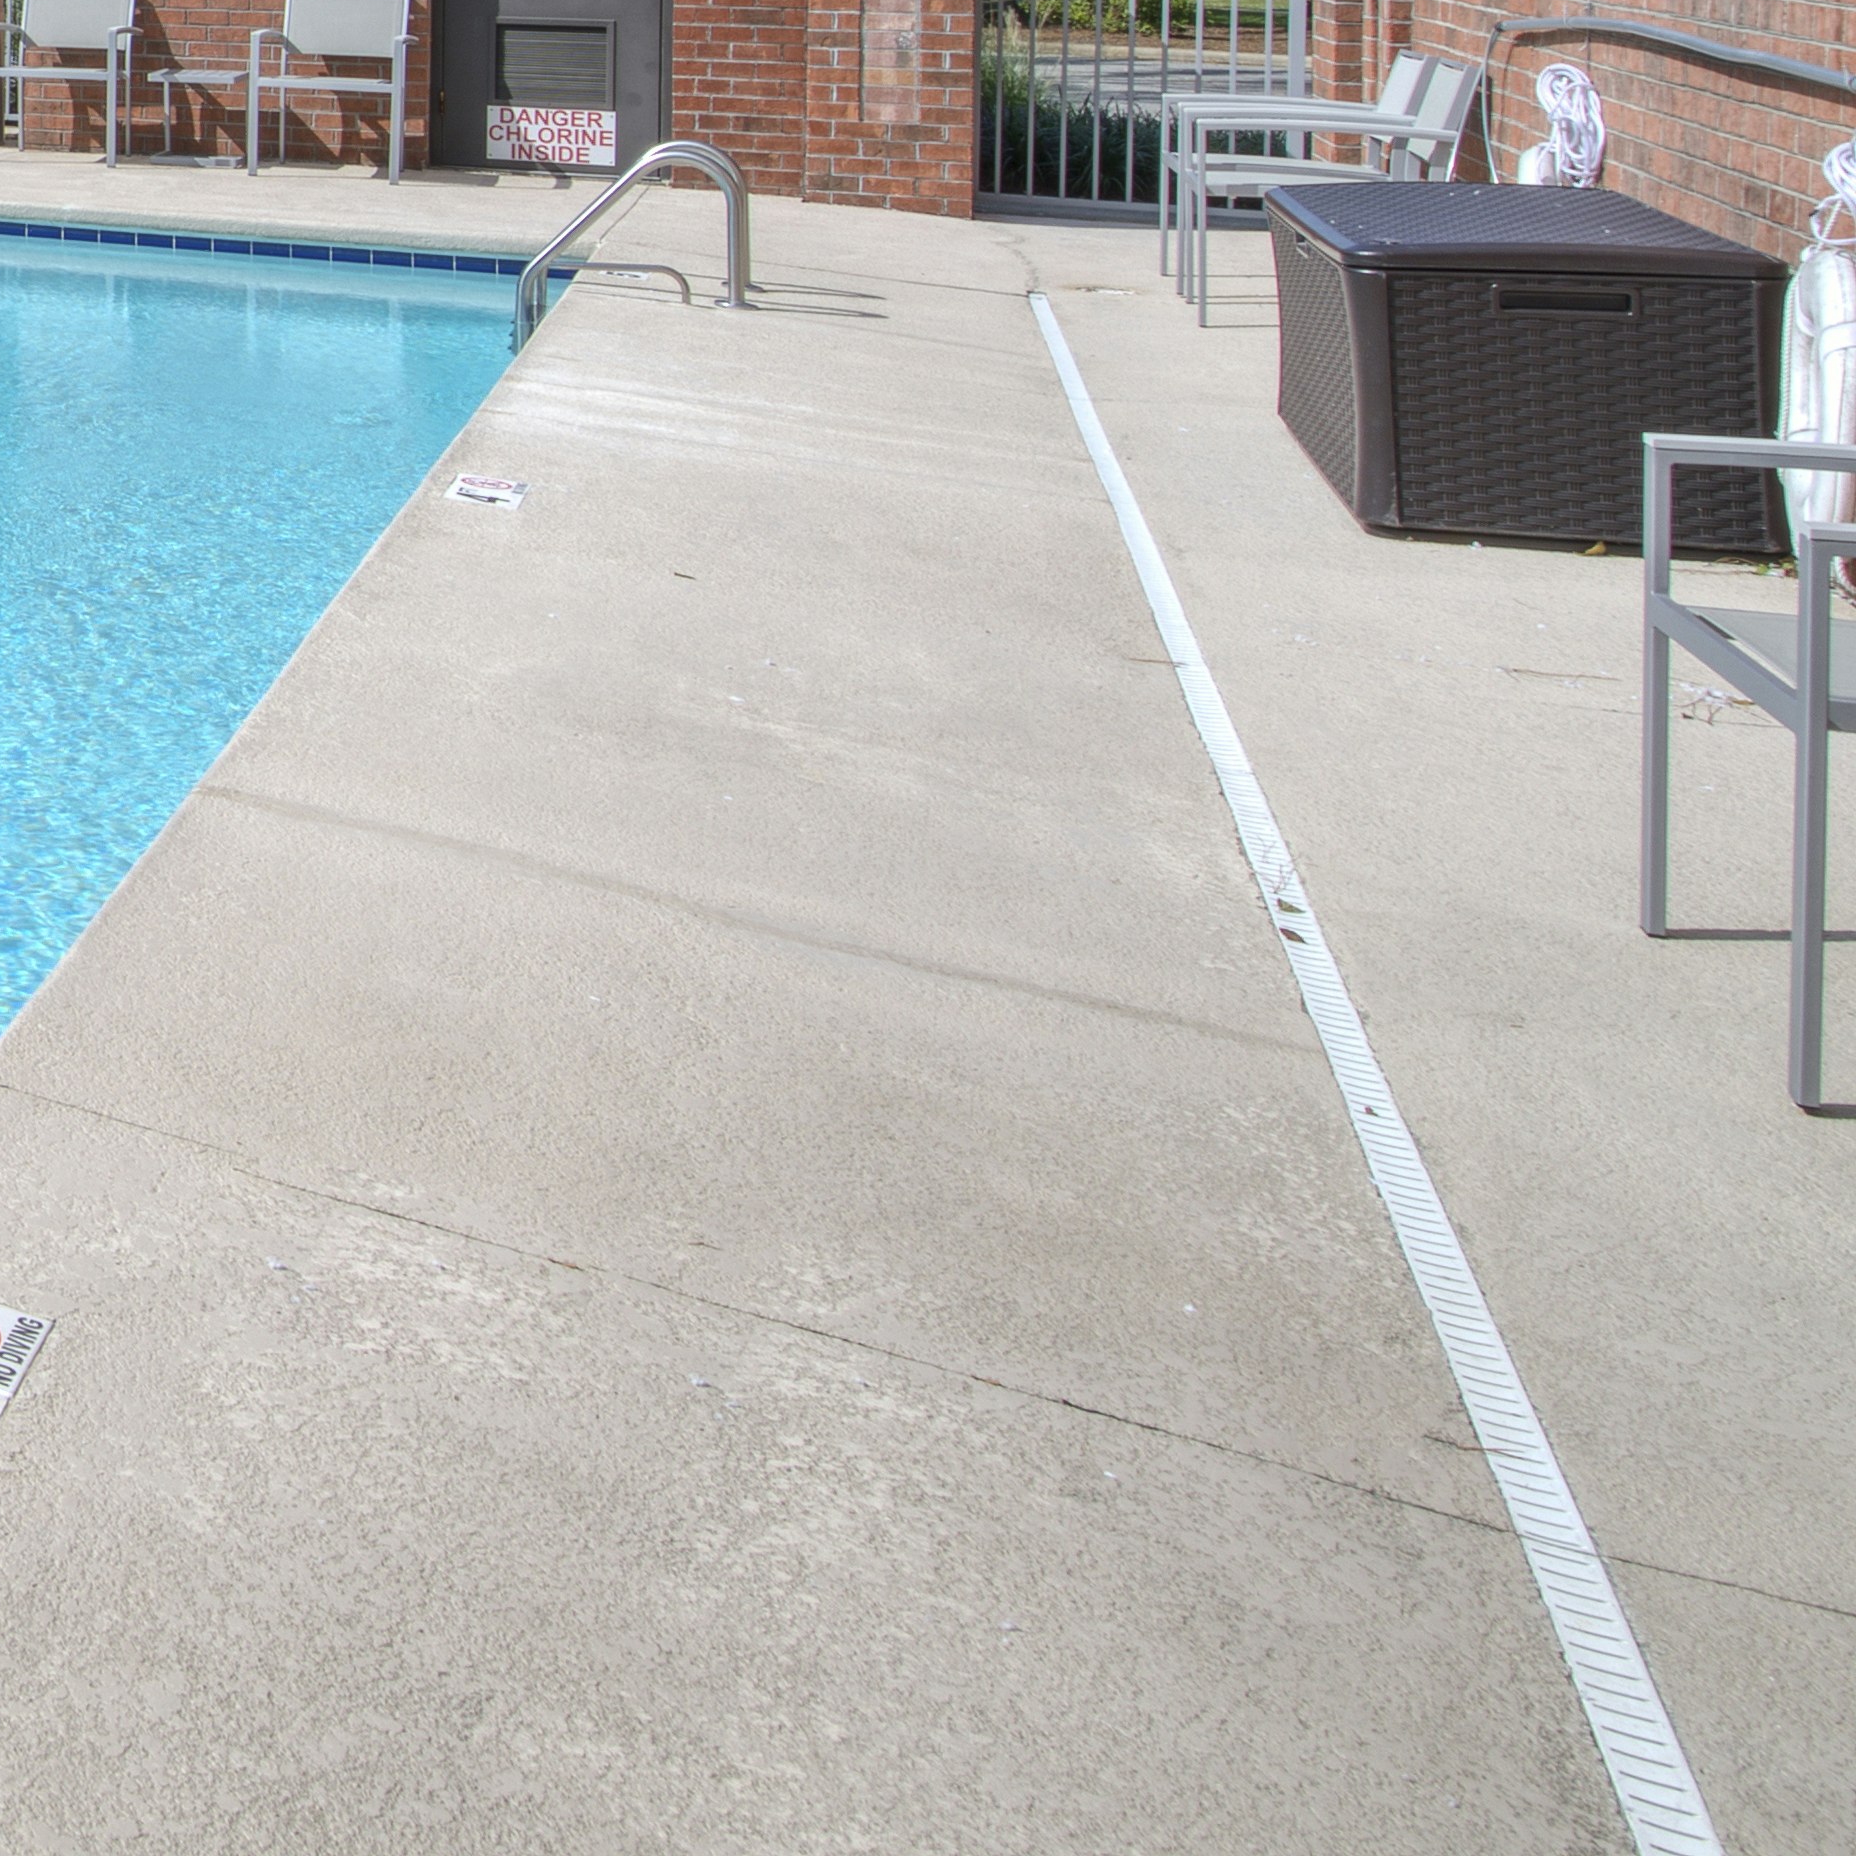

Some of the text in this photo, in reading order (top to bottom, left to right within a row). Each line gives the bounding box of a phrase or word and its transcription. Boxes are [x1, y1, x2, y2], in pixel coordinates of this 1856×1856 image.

[499, 108, 603, 128] DANGER
[489, 124, 614, 147] CHLORINE
[511, 143, 590, 163] INSIDE
